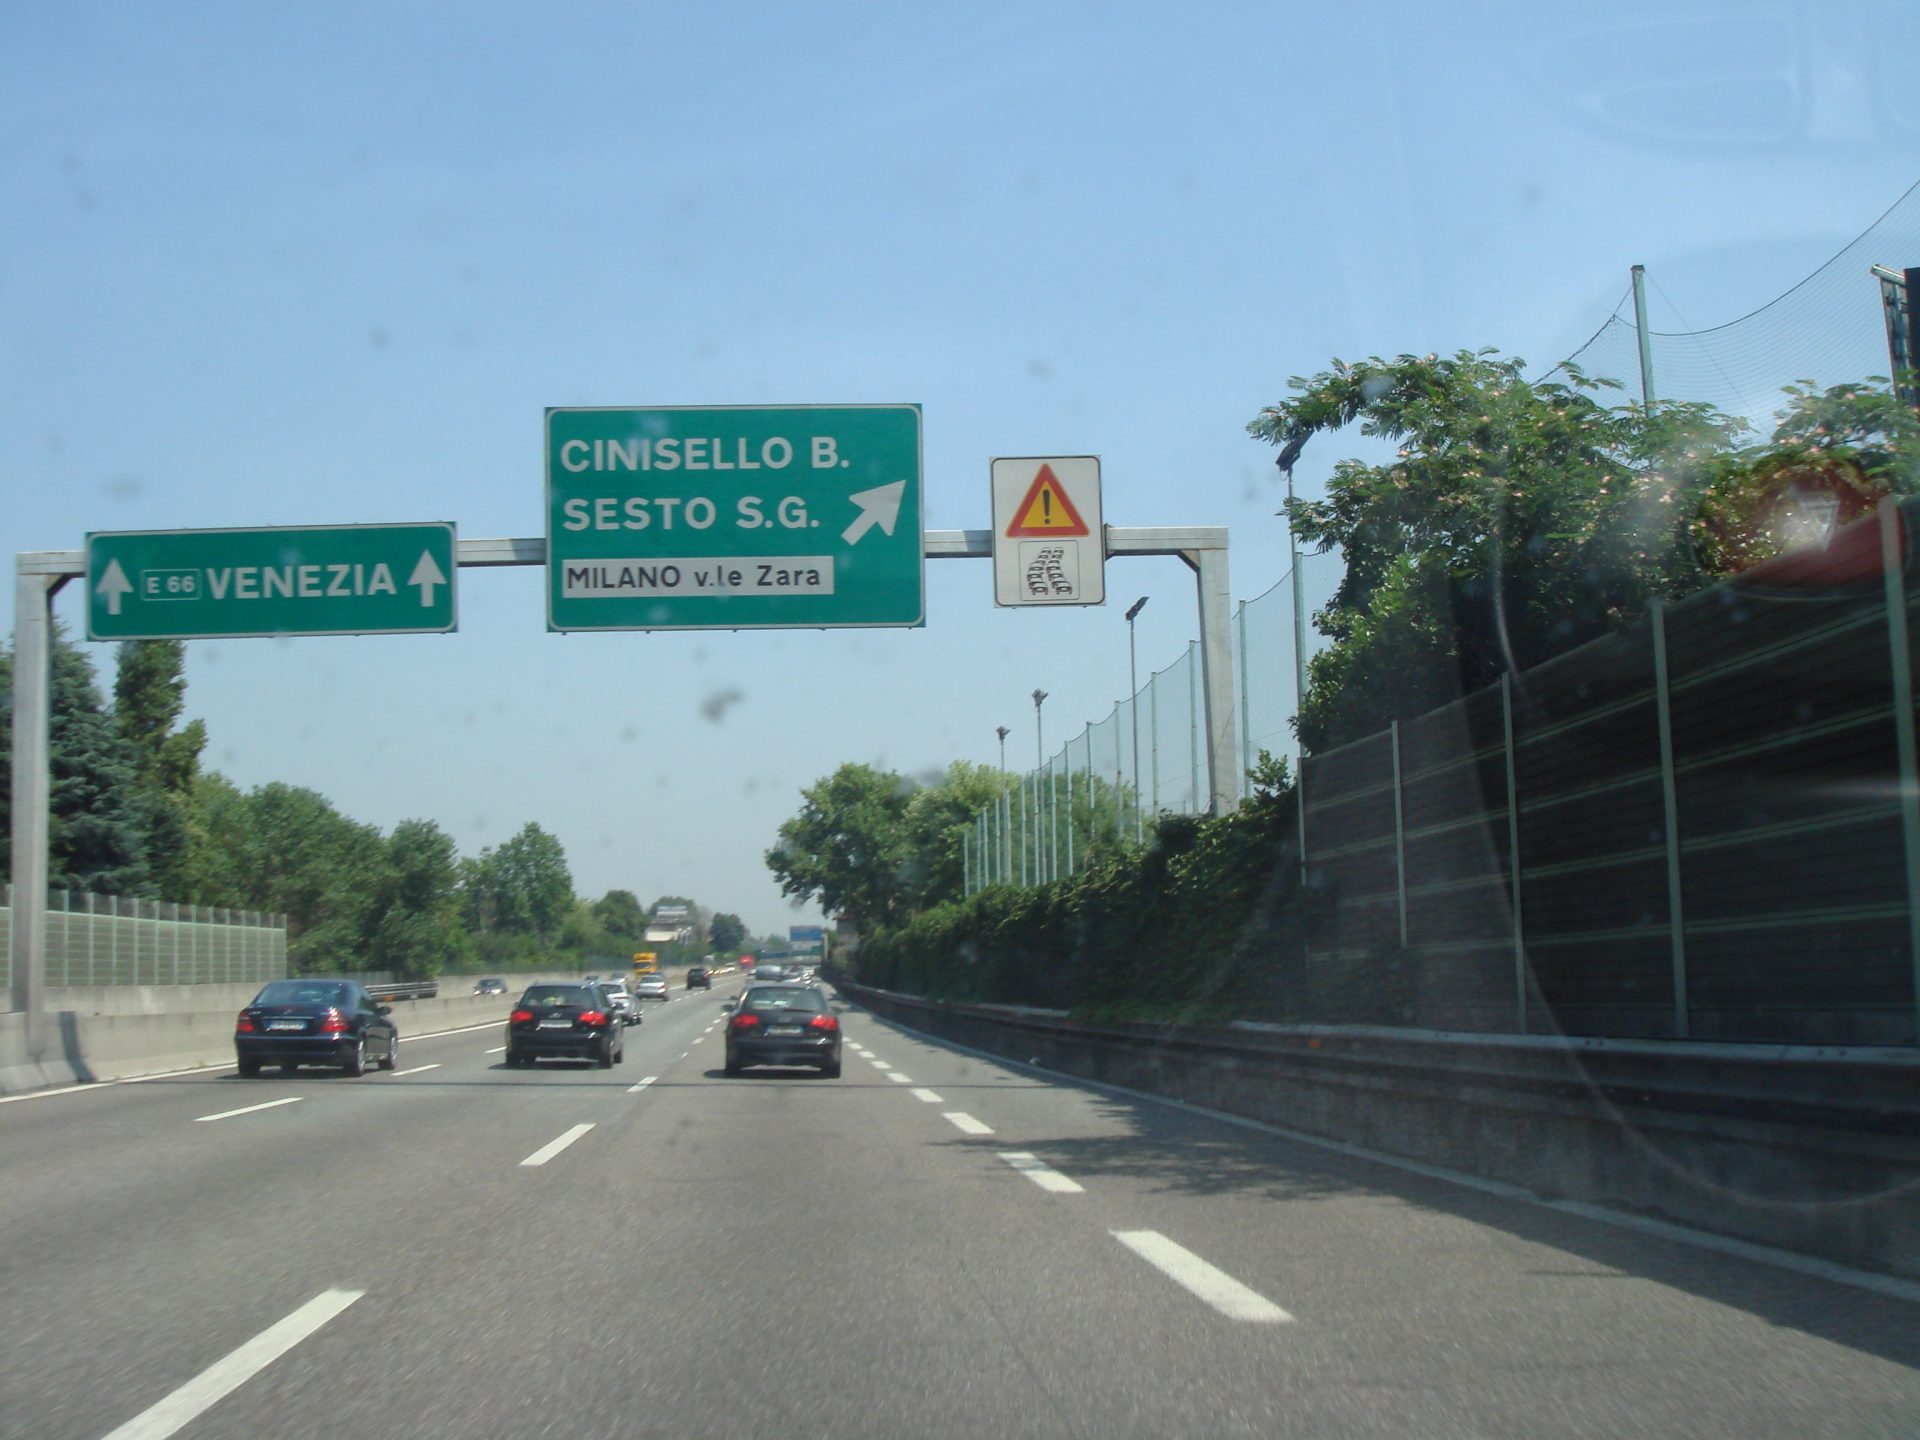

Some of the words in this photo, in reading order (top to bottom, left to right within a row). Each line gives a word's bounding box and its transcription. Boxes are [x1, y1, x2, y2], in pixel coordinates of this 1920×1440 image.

[560, 437, 793, 472] CINISELLO
[812, 436, 850, 468] B.
[563, 497, 716, 531] SESTO
[736, 496, 820, 529] S.G.
[146, 576, 160, 594] E
[166, 575, 196, 593] 66
[206, 563, 397, 600] VENEZIA
[567, 565, 681, 589] MILANO
[694, 566, 742, 587] v.le
[756, 564, 820, 587] Zara
